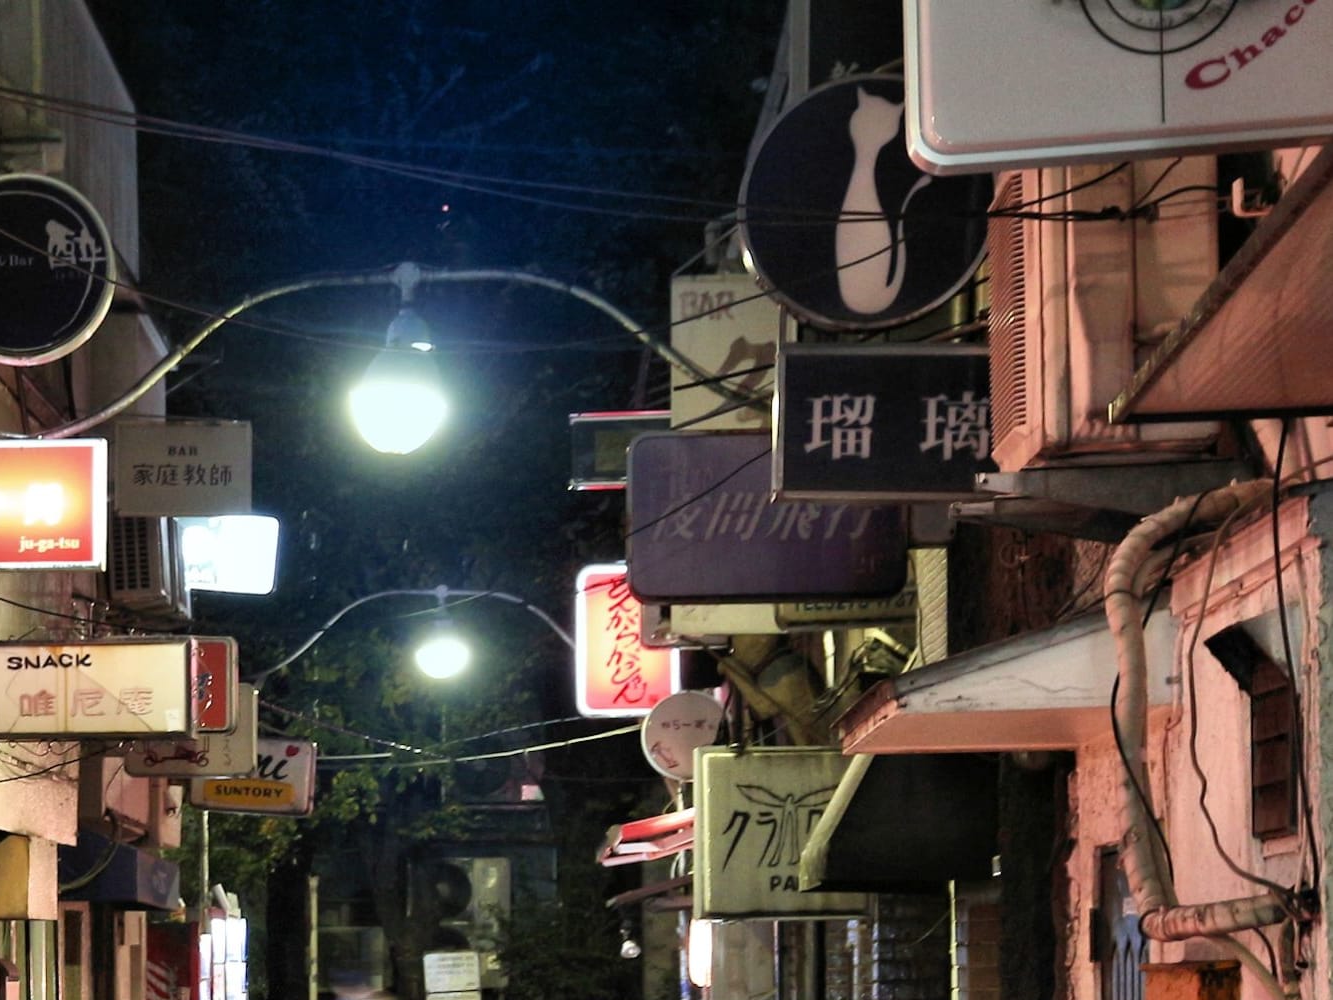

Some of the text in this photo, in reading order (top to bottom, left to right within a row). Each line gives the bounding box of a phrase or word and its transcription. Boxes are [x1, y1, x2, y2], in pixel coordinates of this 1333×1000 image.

[1184, 0, 1316, 90] Chac
[804, 391, 989, 460] 瑠璃
[167, 445, 198, 456] BAR
[133, 463, 233, 487] 家庭教師
[7, 653, 92, 671] SNACK
[215, 785, 284, 798] SUNTORY
